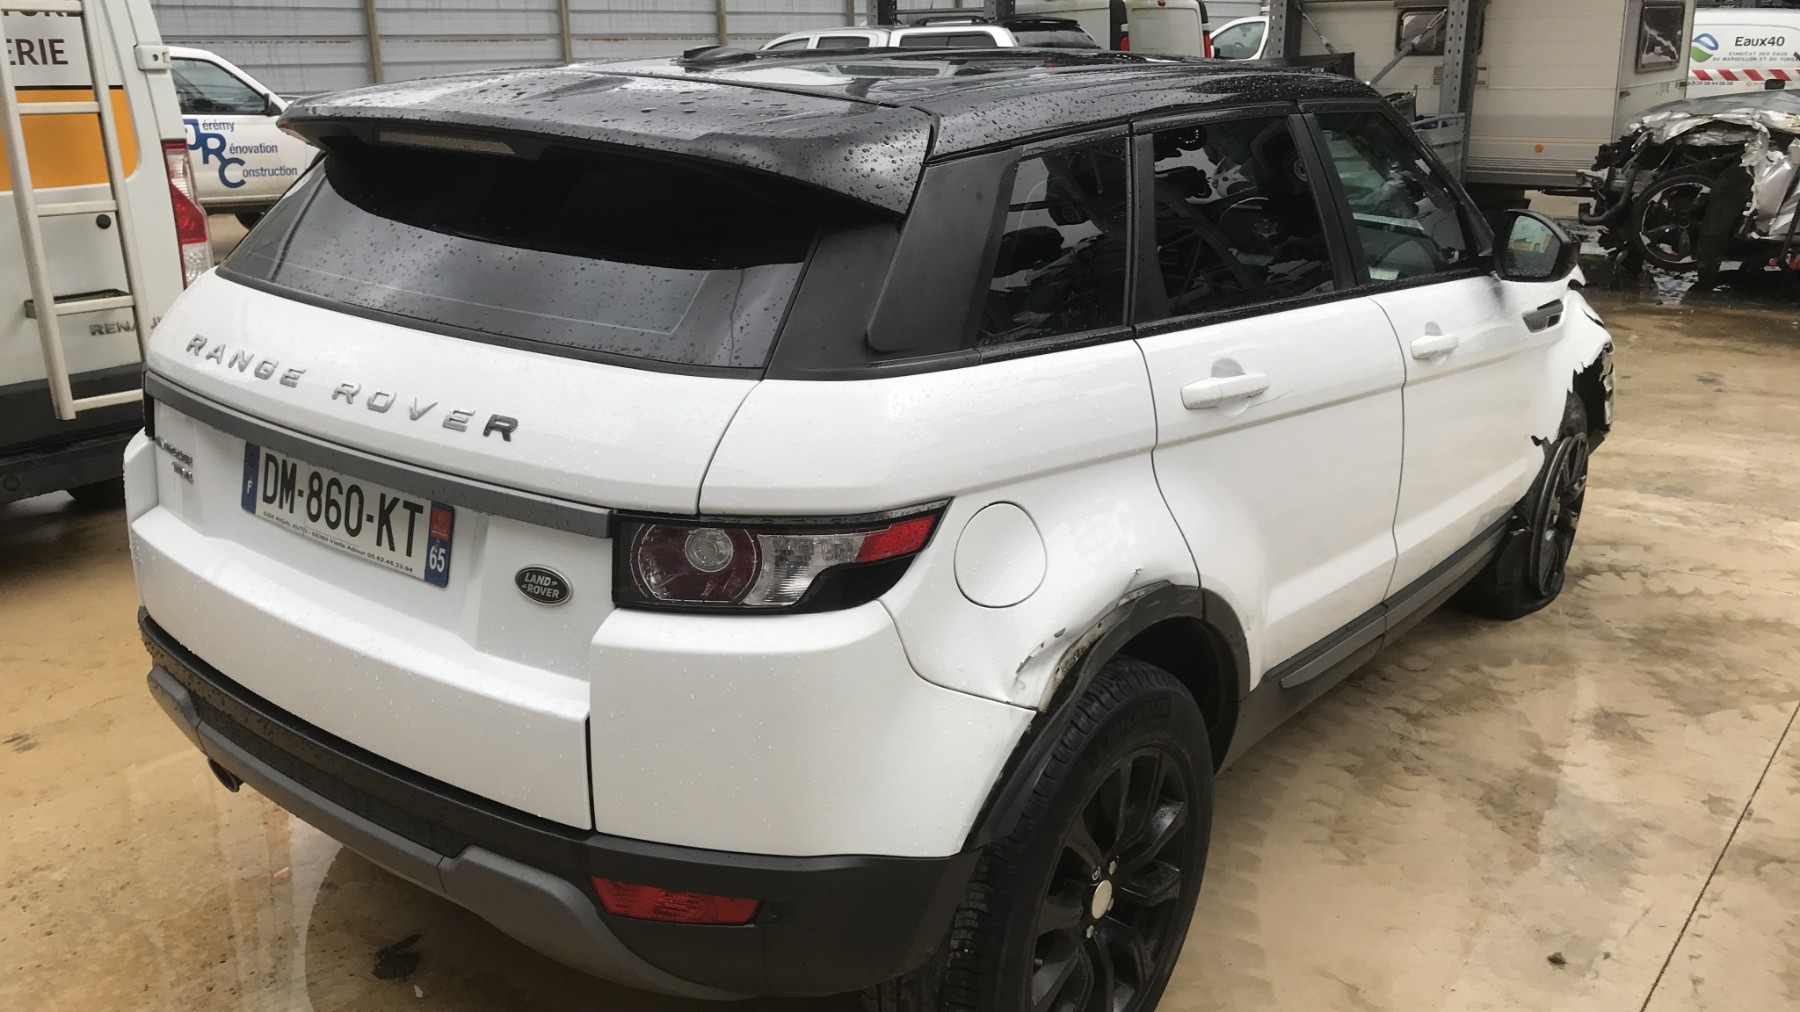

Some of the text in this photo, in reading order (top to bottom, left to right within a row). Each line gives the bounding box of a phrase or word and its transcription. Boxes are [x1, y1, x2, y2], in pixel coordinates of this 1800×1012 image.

[1734, 36, 1786, 47] Eaux40
[185, 333, 520, 442] RANGE ROVER
[246, 479, 254, 494] F
[262, 452, 425, 558] DM-860-KT
[429, 544, 446, 573] 65
[292, 523, 308, 534] AUTO
[524, 572, 552, 587] LAND
[526, 583, 560, 599] ROVER
